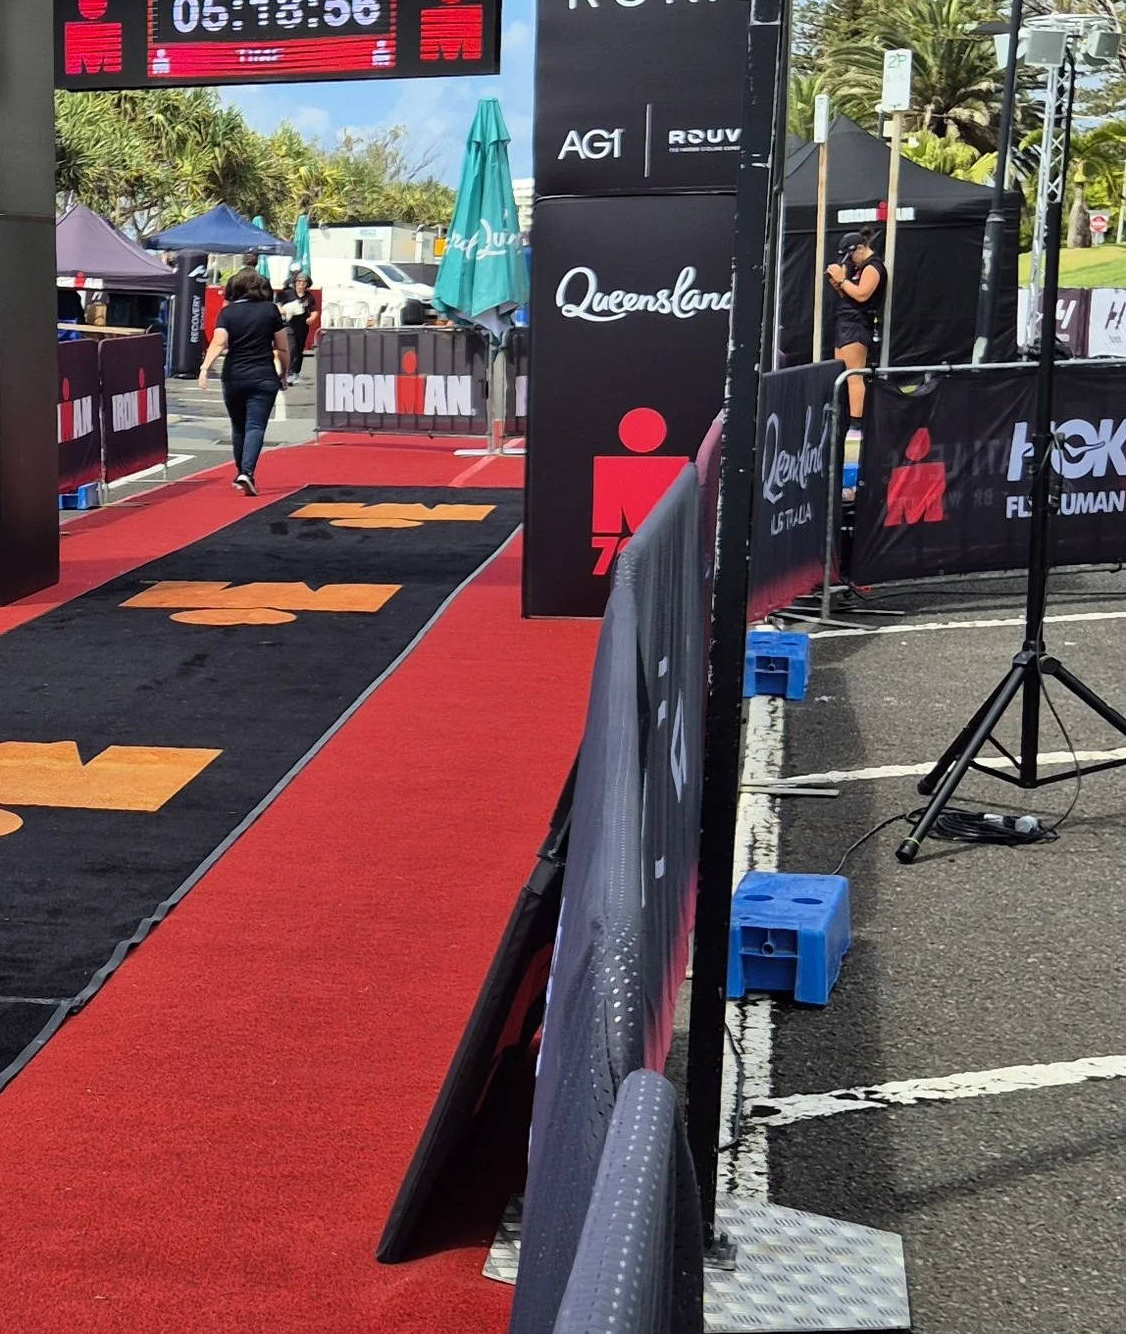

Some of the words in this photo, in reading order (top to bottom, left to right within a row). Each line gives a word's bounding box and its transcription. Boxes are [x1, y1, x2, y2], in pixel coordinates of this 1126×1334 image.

[557, 127, 626, 160] AG1
[111, 384, 162, 433] IRONMAN
[325, 373, 473, 416] IRONMAN
